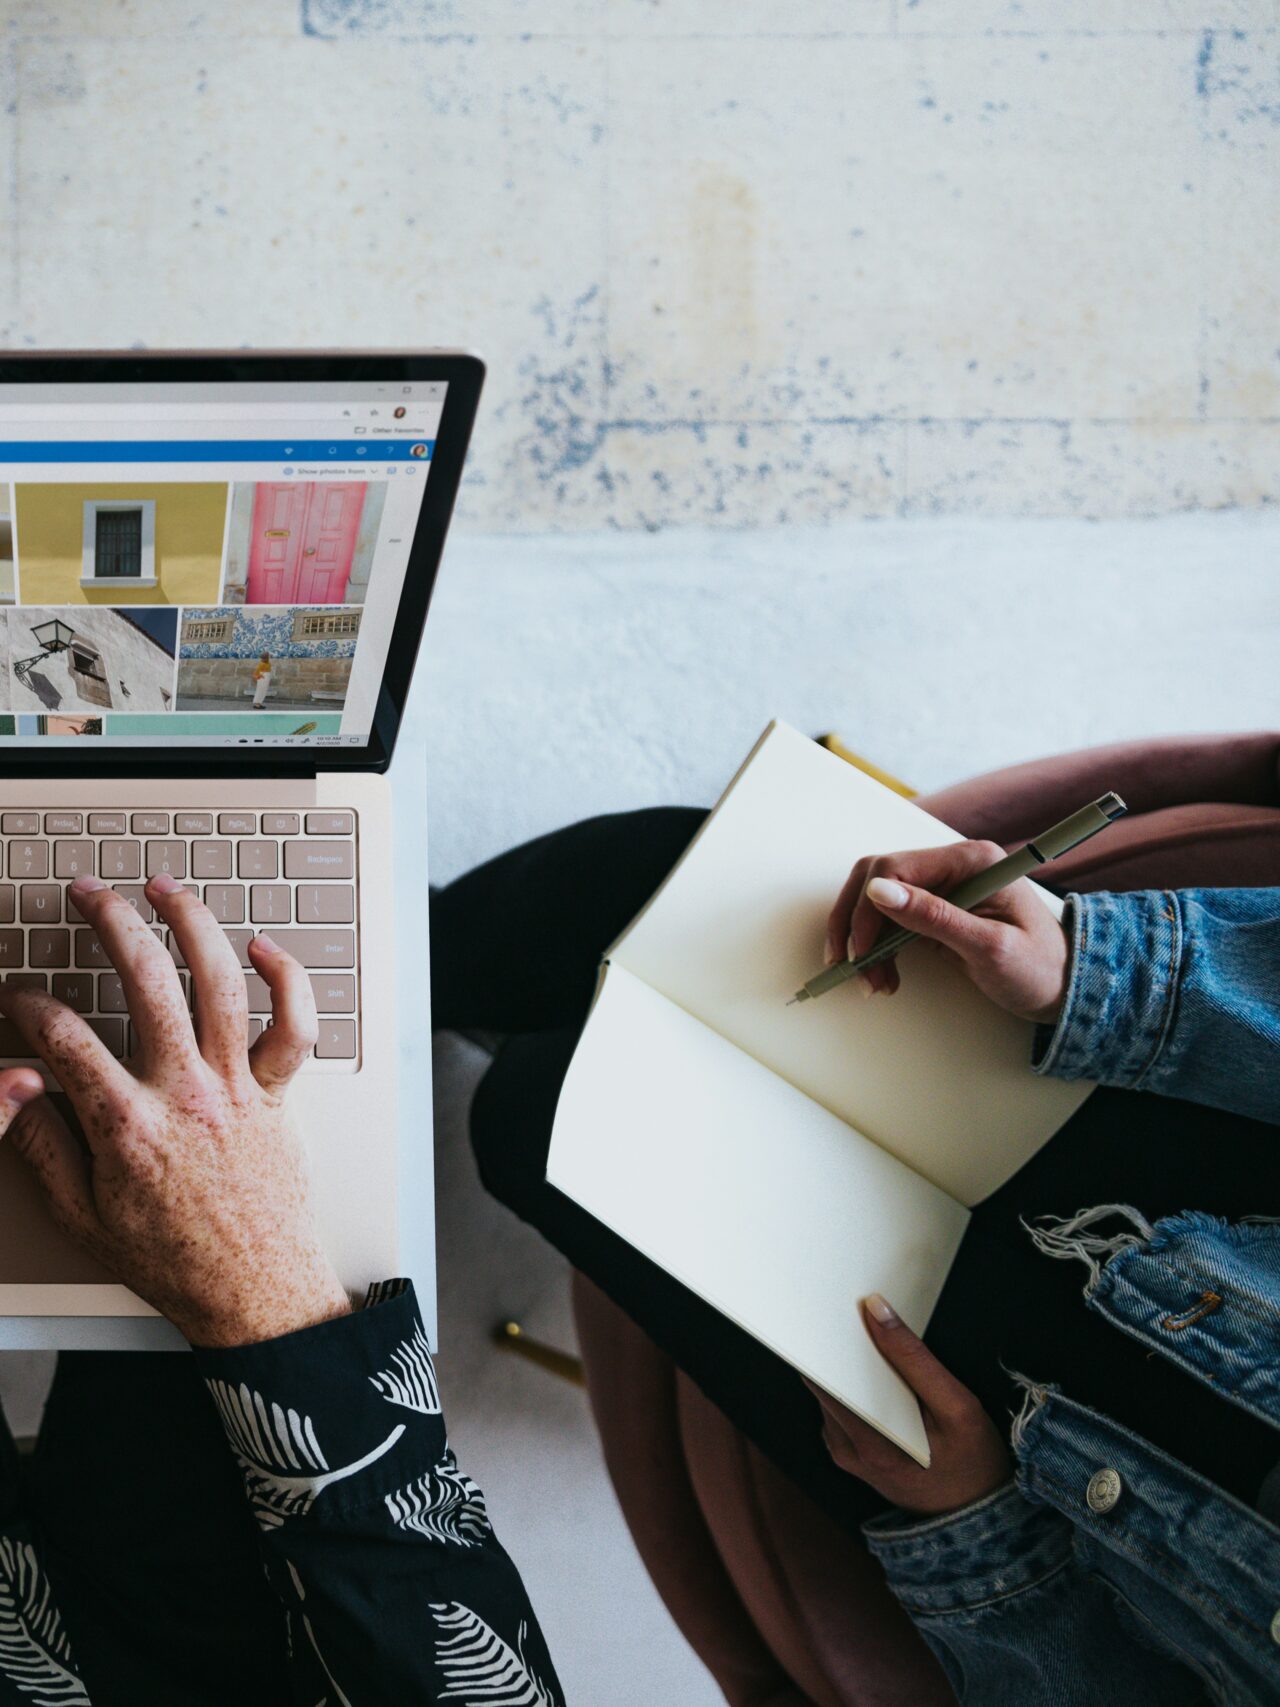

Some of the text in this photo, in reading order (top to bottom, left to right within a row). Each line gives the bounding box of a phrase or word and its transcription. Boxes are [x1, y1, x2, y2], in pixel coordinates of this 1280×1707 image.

[297, 467, 318, 475] Show
[320, 467, 346, 476] photos
[97, 819, 117, 827] Home
[144, 819, 157, 828] End
[307, 855, 343, 865] Backspace
[25, 862, 32, 871] 7
[70, 862, 78, 871] 8
[117, 862, 124, 871] 9
[162, 862, 170, 871] 0
[36, 898, 45, 909] U
[0, 943, 8, 953] H
[46, 943, 51, 954] J
[92, 943, 100, 953] K
[325, 944, 344, 952] Enter
[67, 988, 78, 998] M
[328, 989, 345, 998] Shift
